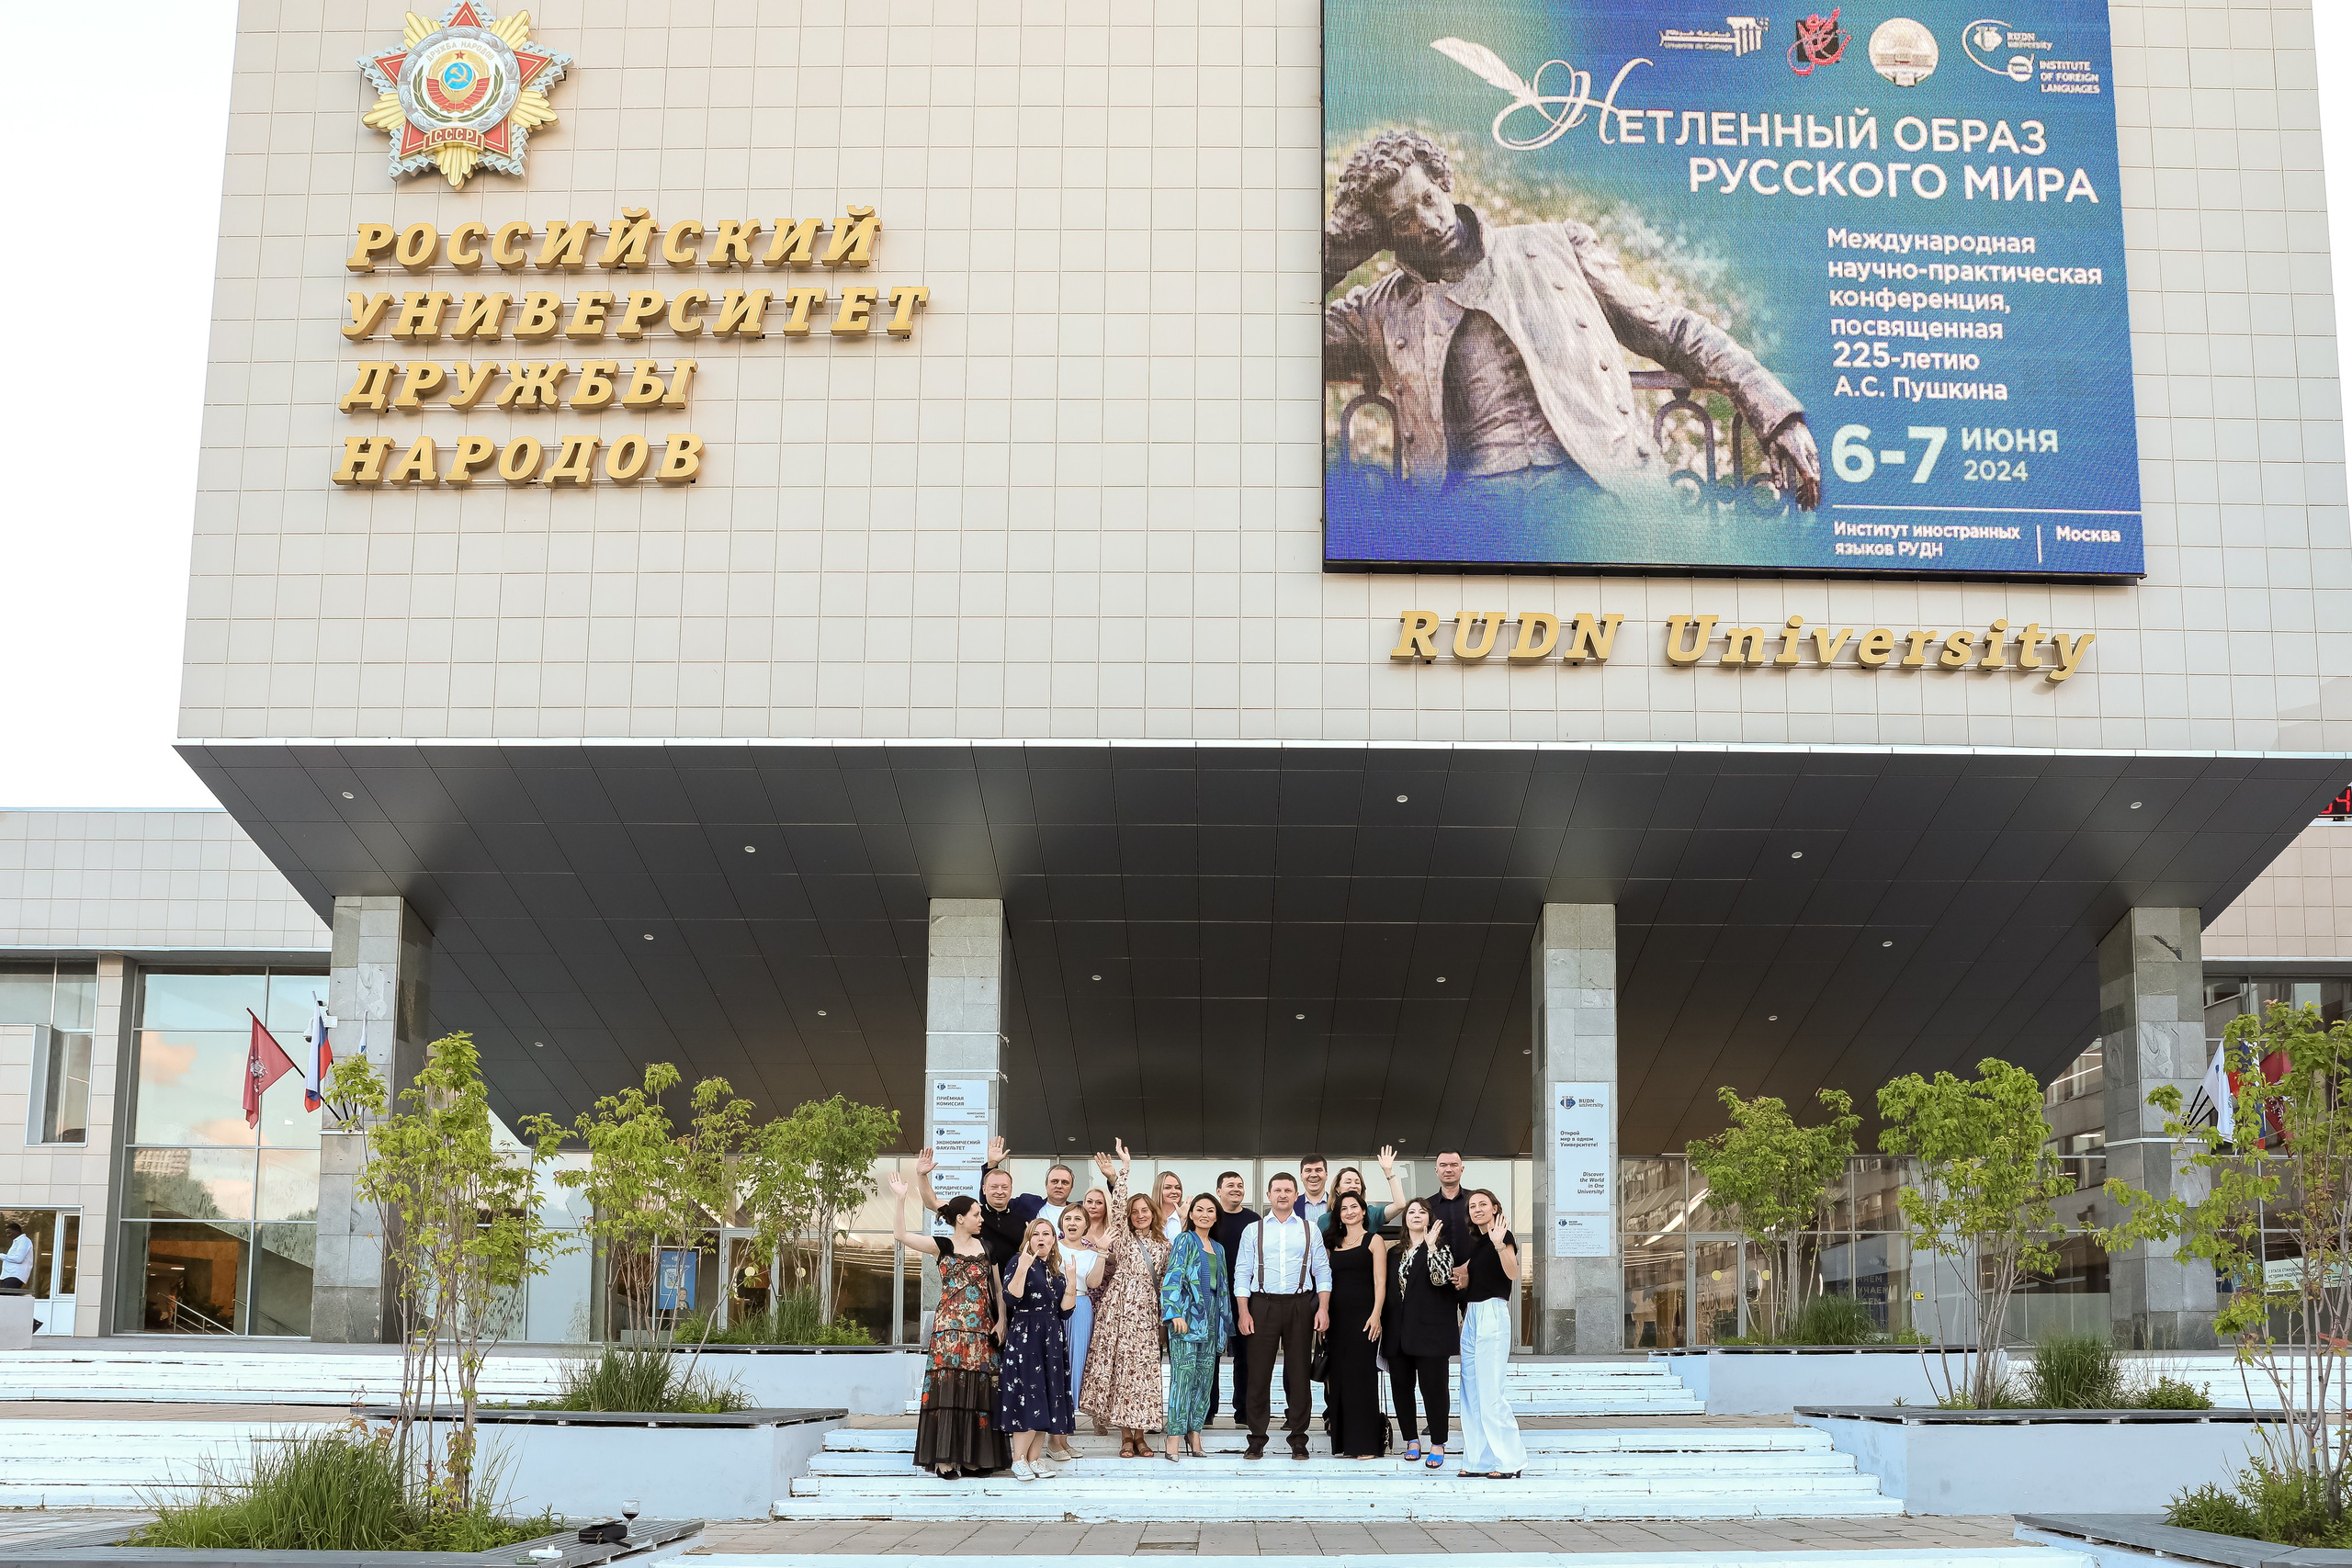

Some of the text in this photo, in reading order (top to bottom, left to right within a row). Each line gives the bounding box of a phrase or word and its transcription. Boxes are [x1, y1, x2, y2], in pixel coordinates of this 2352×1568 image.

[426, 40, 494, 62] ДРУЖБА НАРОДОВ
[2039, 60, 2091, 71] INSTITUTE
[2041, 73, 2099, 83] OF FOREIGN
[2041, 84, 2100, 94] LANGUAGES
[434, 129, 474, 141] СССР
[1894, 116, 2048, 156] ОБРАЗ
[1689, 157, 2100, 204] РУССКОГО МИРА
[345, 205, 883, 274] РОССИЙСКИЙ
[1827, 228, 2036, 254] Международная
[1827, 260, 2103, 286] научно-практическая
[340, 286, 931, 341] УНИВЕРСИТЕТ
[1829, 288, 2011, 314] конференция,
[1830, 318, 2004, 341] посвященная
[1832, 342, 1981, 371] 225-летию
[337, 358, 700, 415] ДРУЖБЫ
[1833, 375, 2008, 402] А.С. Пушкина
[332, 433, 707, 487] НАРОДОВ
[1963, 459, 2029, 481] 2024
[1834, 521, 2121, 543] Институт иностранных Москва
[1835, 541, 1943, 558] языков РУДН
[1389, 610, 2096, 683] RUDN University
